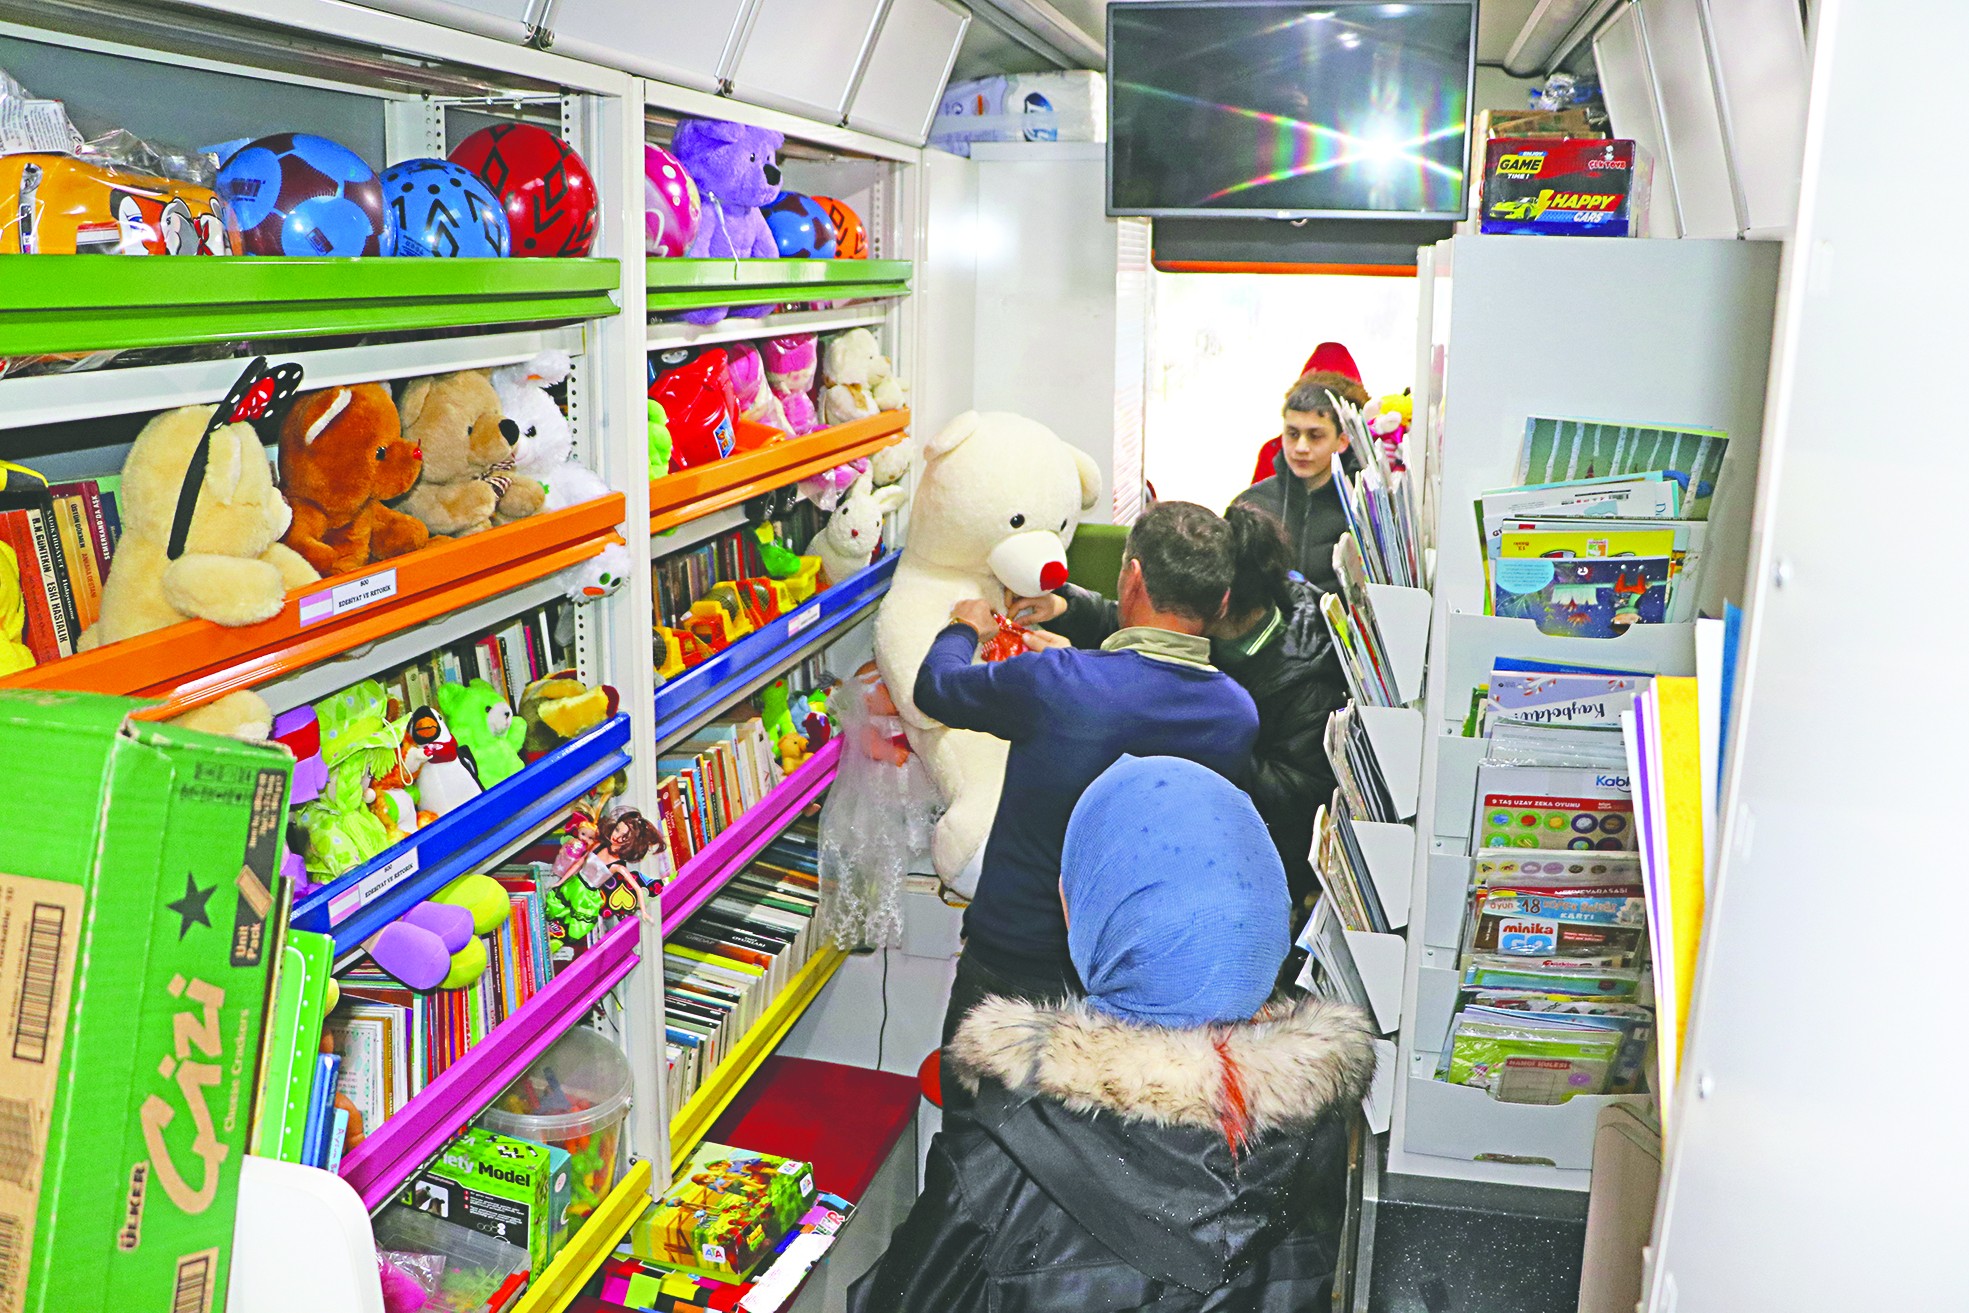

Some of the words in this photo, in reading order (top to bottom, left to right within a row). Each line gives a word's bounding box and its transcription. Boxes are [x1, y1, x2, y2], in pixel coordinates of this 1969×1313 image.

[1500, 159, 1543, 171] GAME
[1550, 193, 1615, 209] HAPPY
[1573, 211, 1604, 223] CARS
[46, 581, 61, 602] ESKİ
[50, 602, 68, 644] HASTALIK
[1534, 800, 1554, 808] ZEKA
[1554, 801, 1581, 809] OYUNU
[1521, 898, 1541, 914] 18
[1503, 922, 1554, 935] minika
[235, 925, 249, 958] Unit
[247, 922, 261, 960] Pack
[229, 1008, 249, 1076] Crackers
[140, 973, 229, 1214] Çizi
[223, 1079, 241, 1132] Cheese
[478, 1161, 531, 1187] Model
[119, 1166, 146, 1250] ÜLKER
[705, 1247, 724, 1259] ATA
